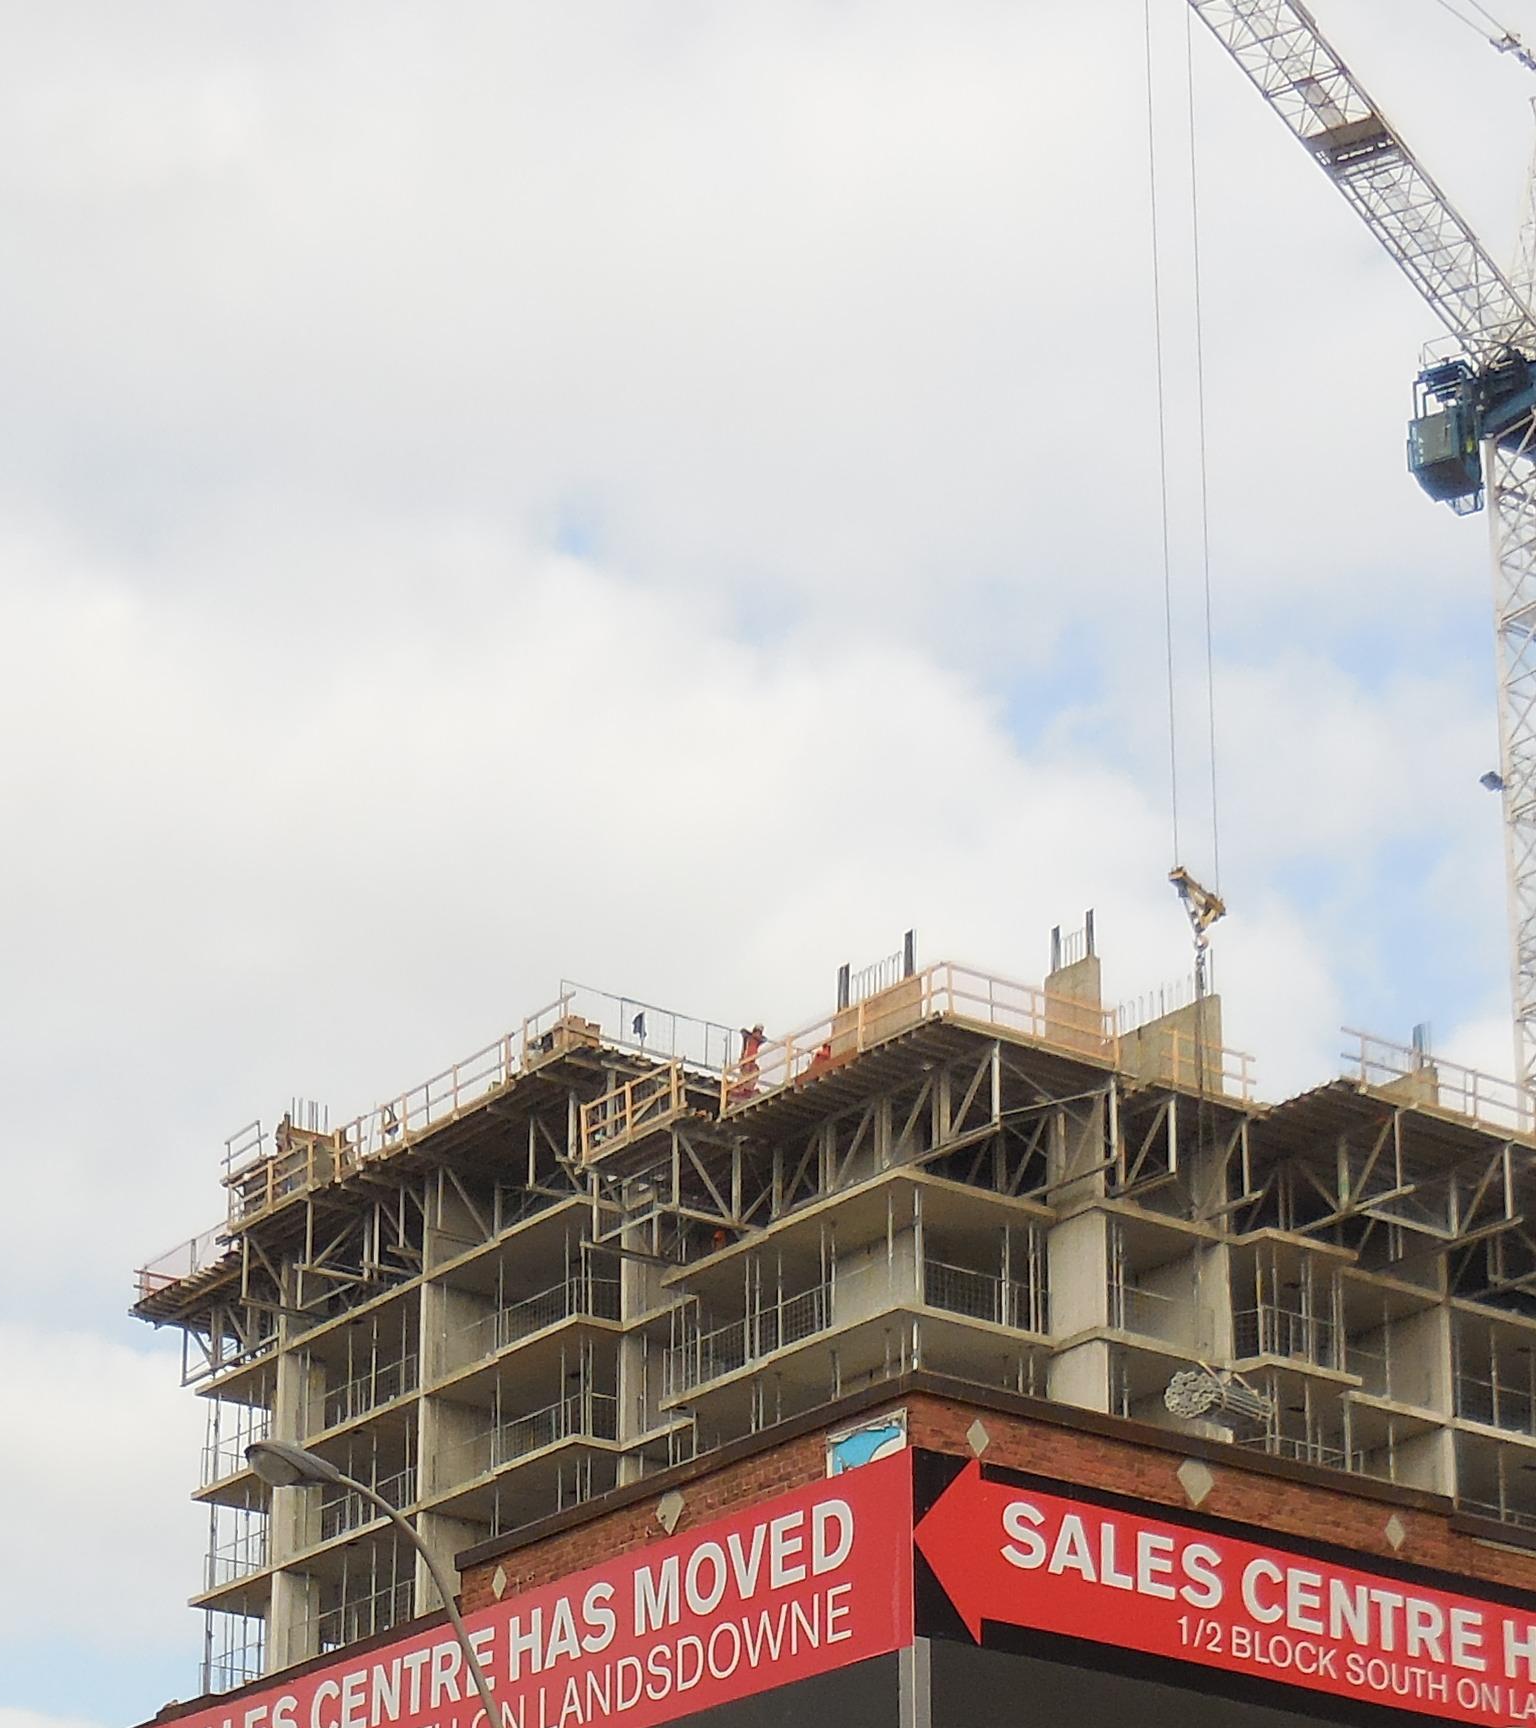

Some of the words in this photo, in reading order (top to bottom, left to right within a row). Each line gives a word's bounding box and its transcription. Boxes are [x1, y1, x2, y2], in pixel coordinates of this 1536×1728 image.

[509, 1582, 617, 1682] HAS
[633, 1499, 855, 1637] MOVED
[999, 1501, 1223, 1609] SALES
[1241, 1559, 1486, 1671] CENTRE
[1177, 1615, 1223, 1653] 1/2
[1231, 1626, 1338, 1680] BLOCK
[1345, 1653, 1447, 1703] SOUTH
[1457, 1678, 1501, 1715] ON
